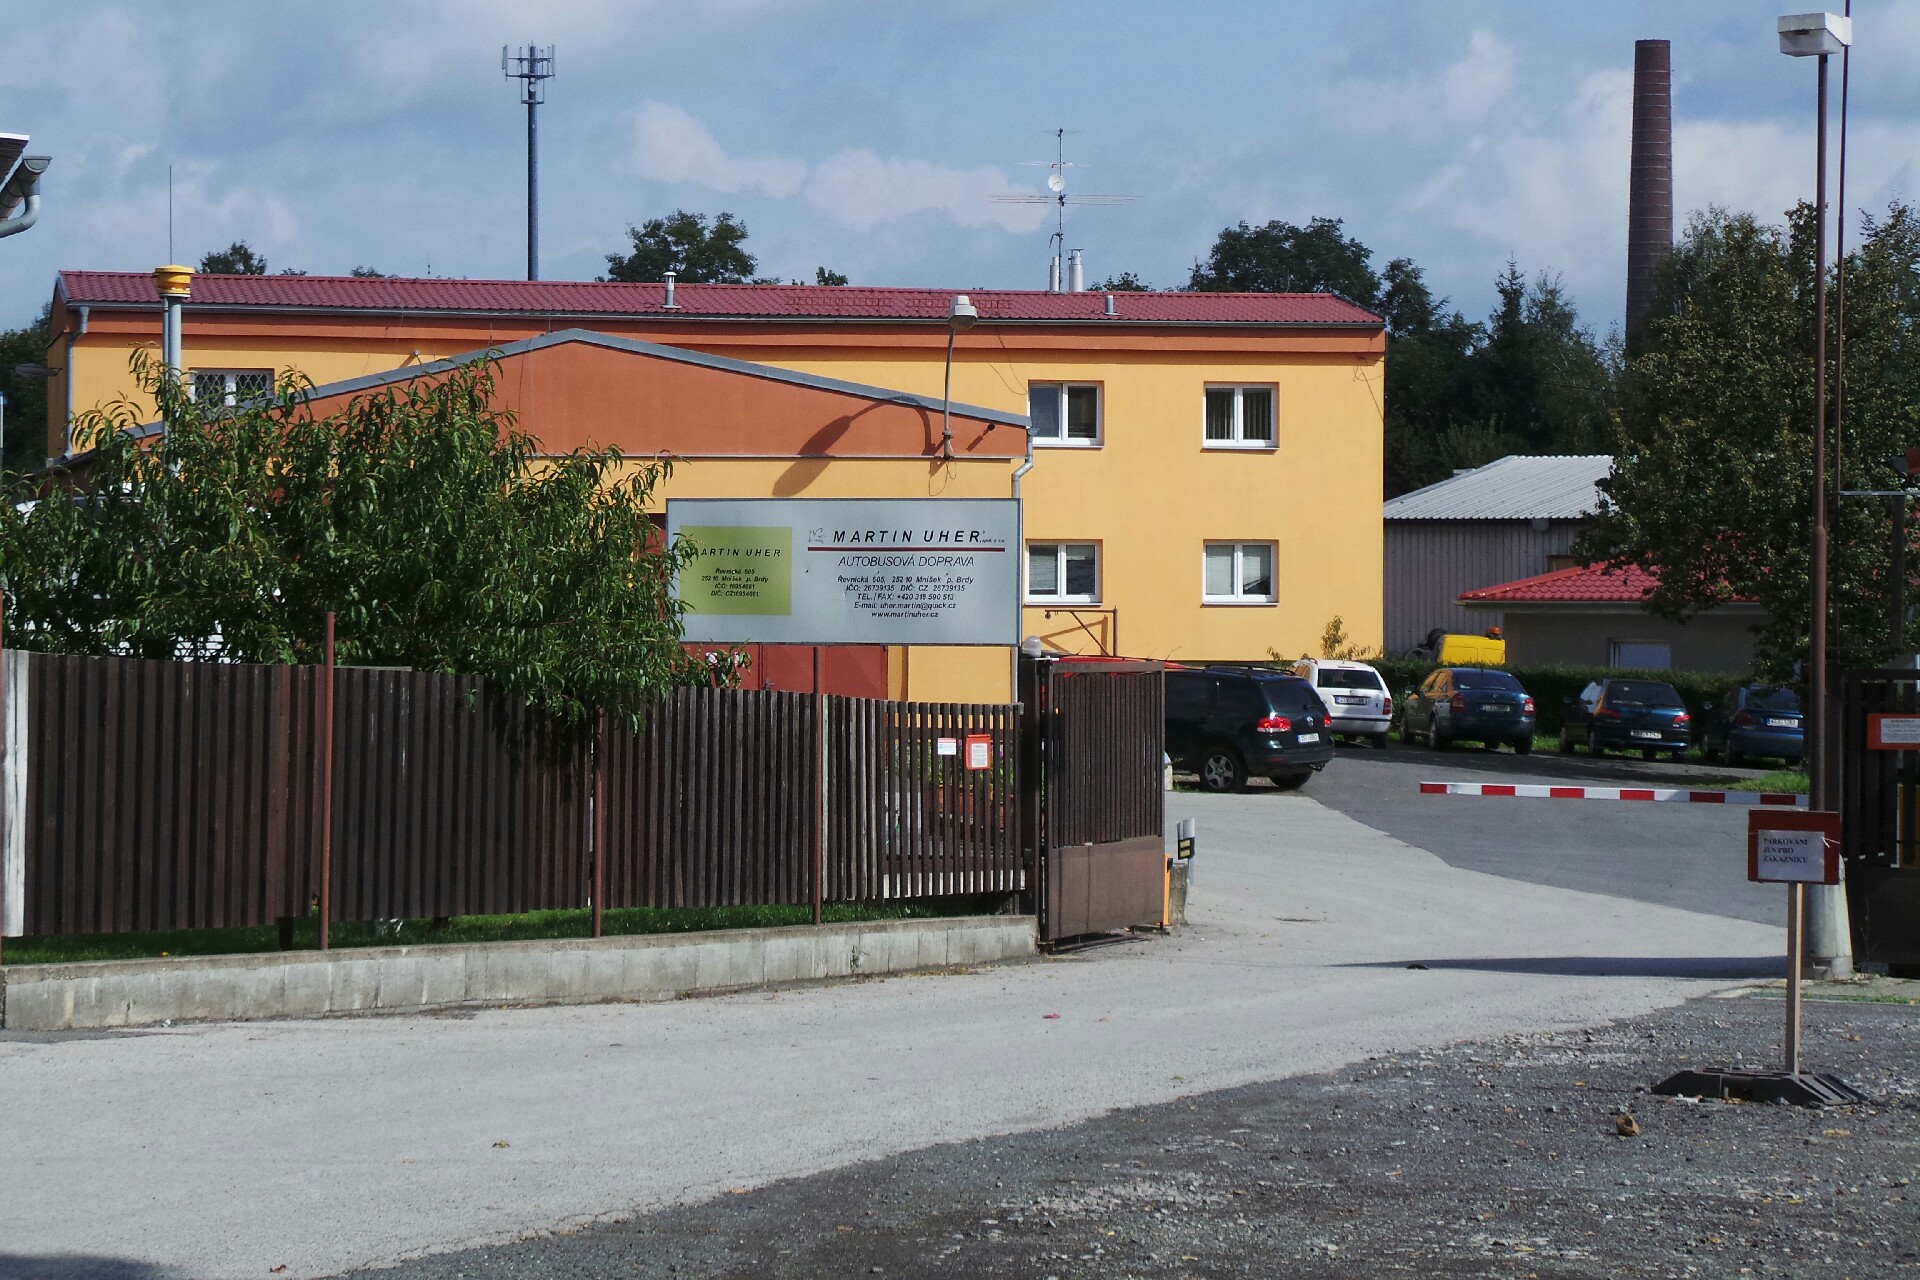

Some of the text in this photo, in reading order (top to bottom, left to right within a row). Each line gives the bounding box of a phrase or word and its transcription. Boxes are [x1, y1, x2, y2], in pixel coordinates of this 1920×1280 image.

[833, 530, 913, 543] MARTIN
[690, 548, 781, 557] ARTIN UHER
[838, 554, 975, 567] AUTOBUSOVÁ DOPRAVA
[753, 575, 769, 584] Brdy
[915, 575, 942, 583] Mníšek
[956, 575, 975, 585] Brdy
[863, 584, 895, 592] 26739135
[900, 583, 915, 592] DIČ:
[918, 584, 929, 592] CZ
[896, 593, 914, 601] +420
[853, 601, 878, 609] E-mail:
[871, 610, 939, 618] www.martinuher.cz
[1777, 846, 1794, 855] PRO
